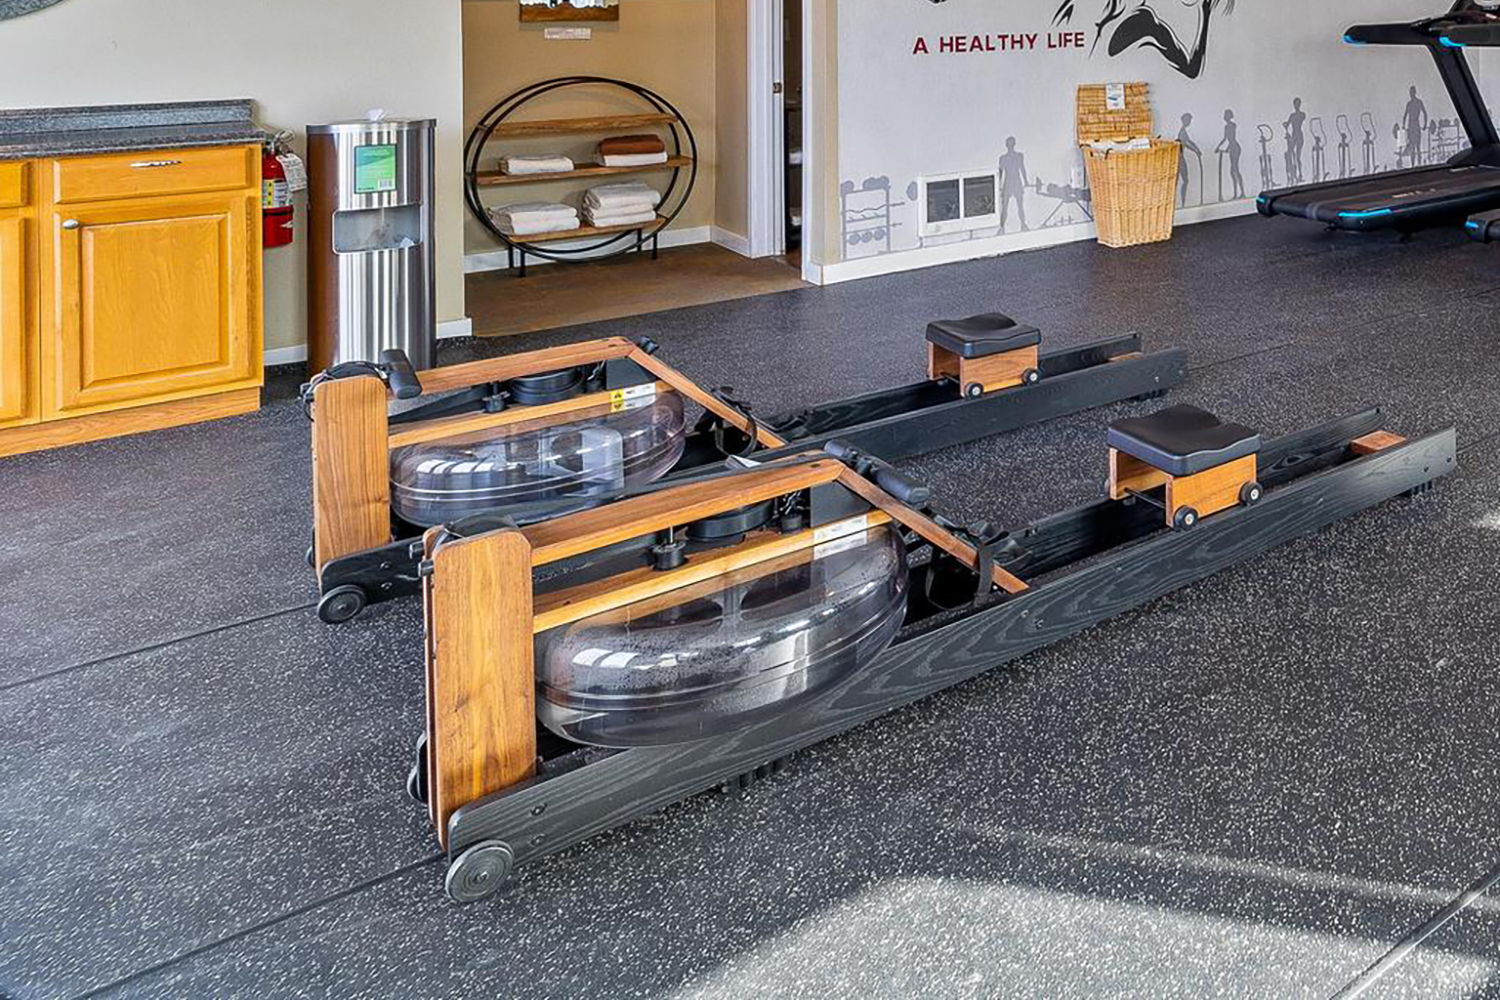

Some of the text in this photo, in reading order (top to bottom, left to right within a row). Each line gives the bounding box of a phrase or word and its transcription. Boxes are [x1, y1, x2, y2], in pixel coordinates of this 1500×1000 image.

[912, 31, 1085, 55] A HEALTHY LIFE
